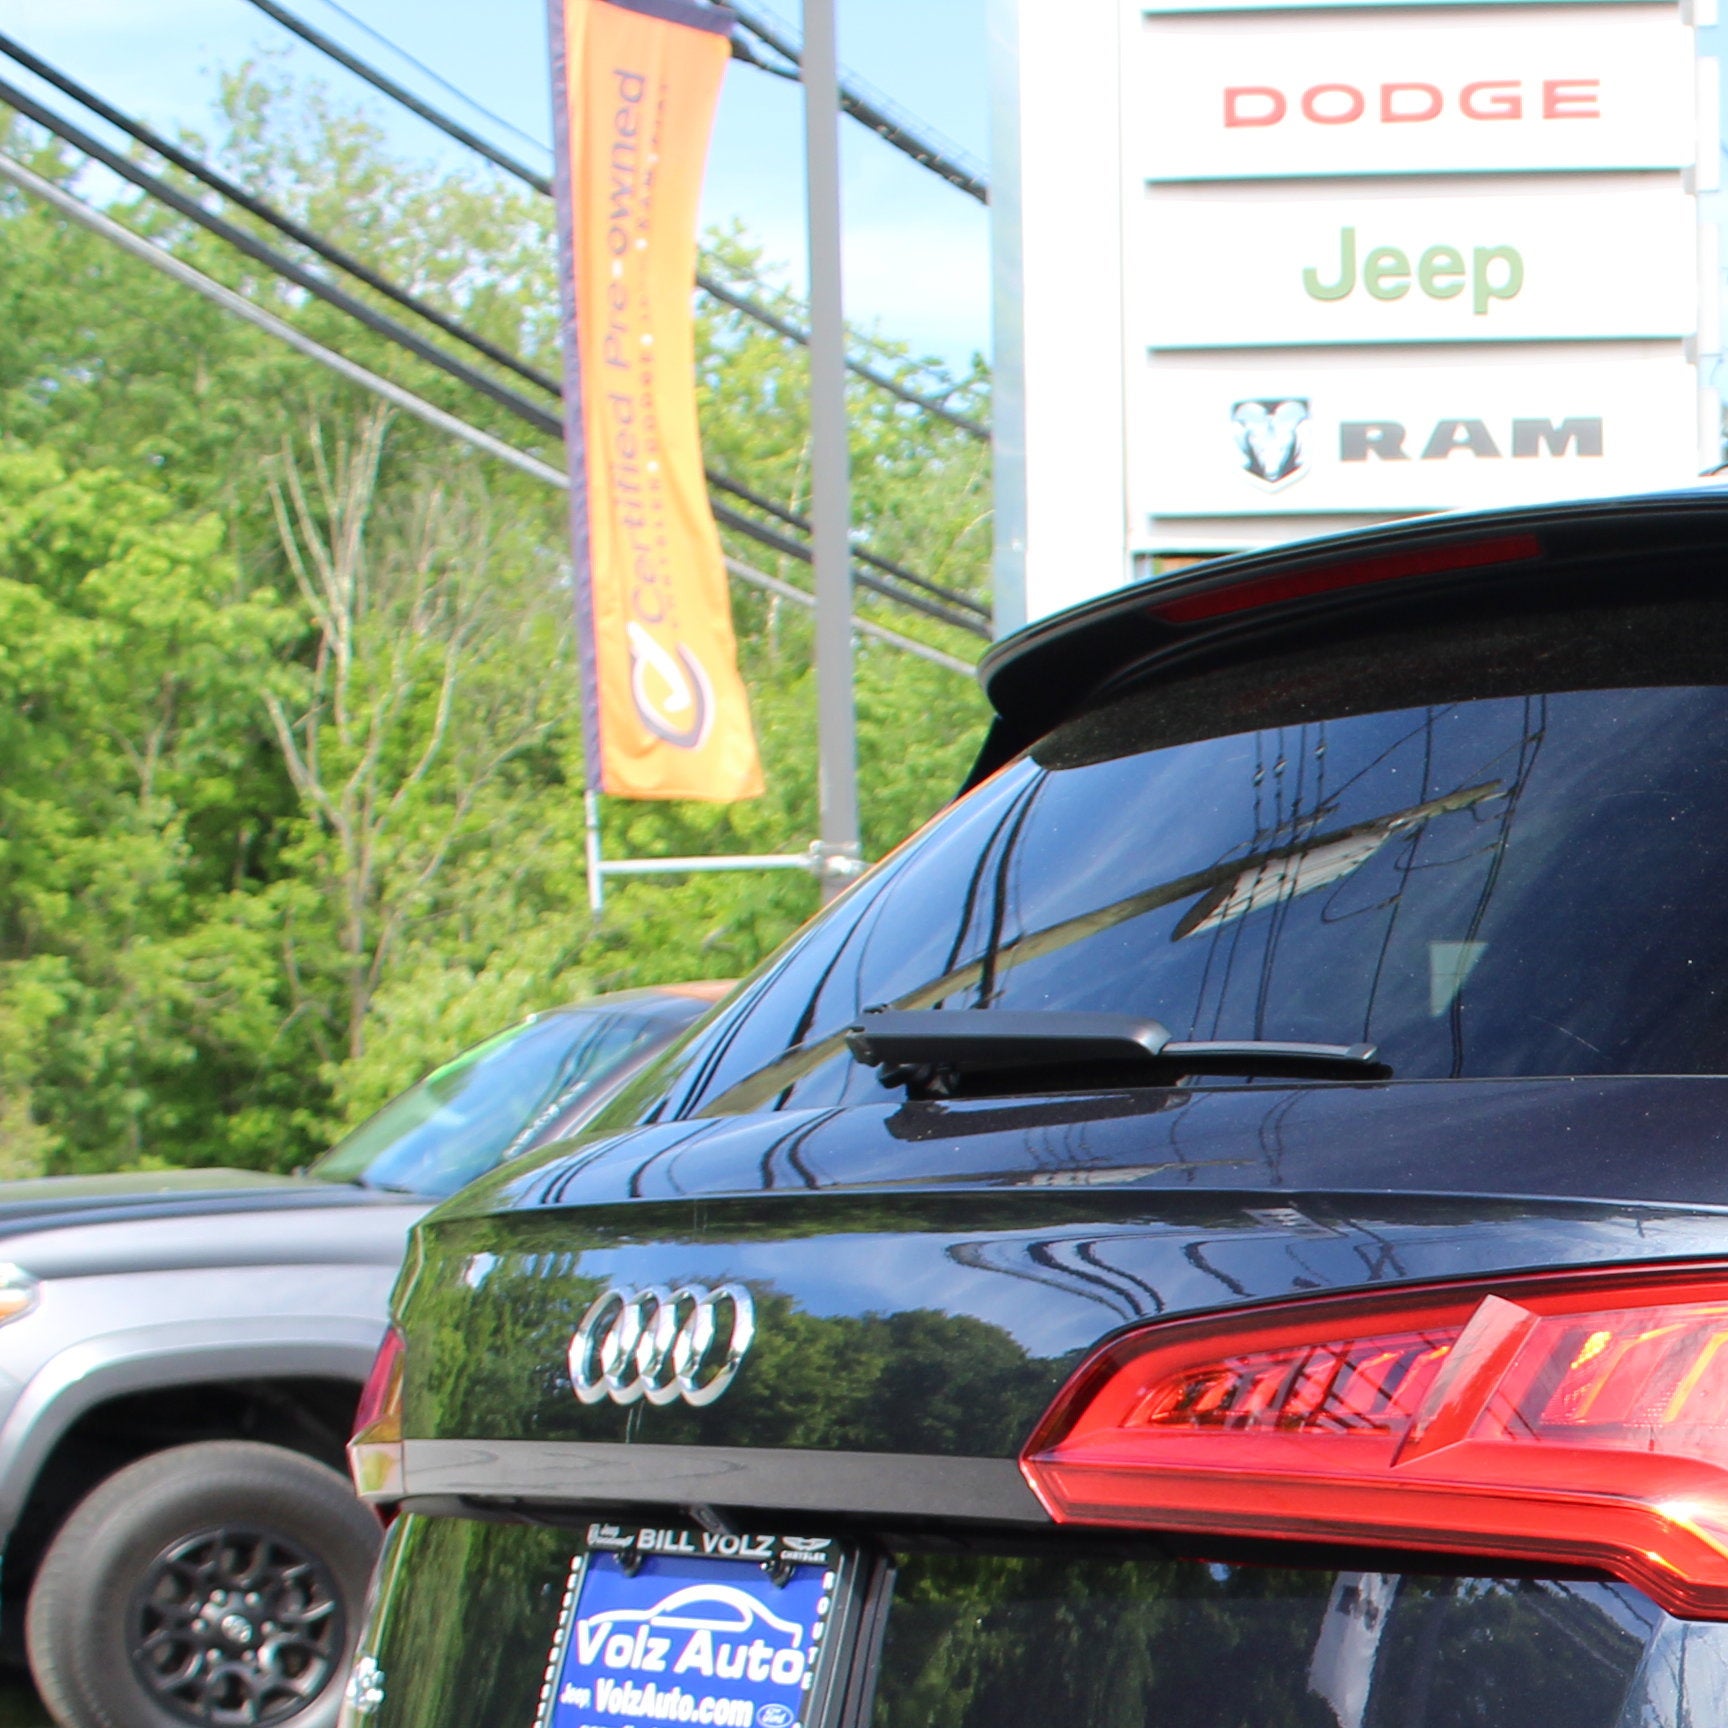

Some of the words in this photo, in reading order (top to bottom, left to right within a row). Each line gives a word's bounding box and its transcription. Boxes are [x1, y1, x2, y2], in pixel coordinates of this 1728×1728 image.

[1223, 79, 1602, 129] DODGE
[1302, 225, 1525, 314] Jeep
[1339, 416, 1604, 463] RAM
[607, 391, 667, 626] Certified
[636, 1528, 695, 1552] BILL
[702, 1532, 776, 1557] VOLZ
[576, 1619, 671, 1673] Volz
[673, 1629, 805, 1685] Auto
[595, 1678, 755, 1728] VolzAuto.com
